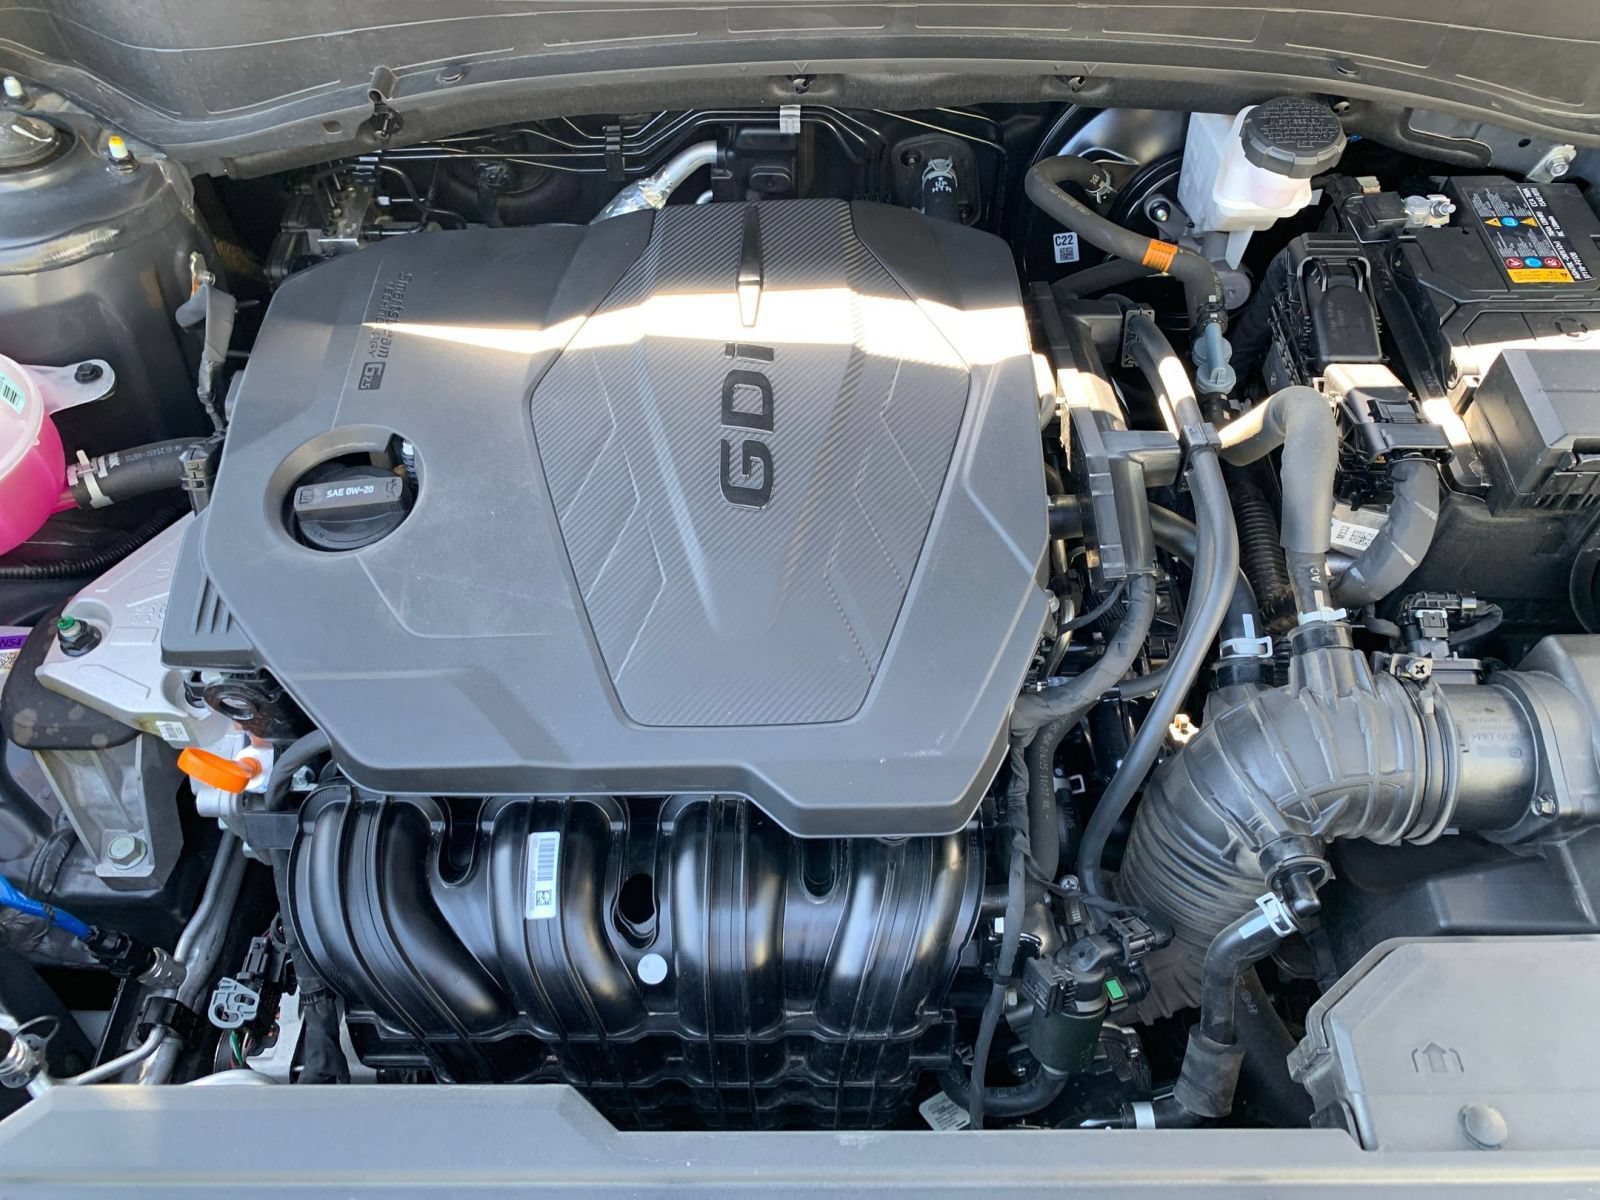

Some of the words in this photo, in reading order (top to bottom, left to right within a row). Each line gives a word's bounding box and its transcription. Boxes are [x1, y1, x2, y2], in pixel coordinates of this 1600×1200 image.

[1055, 235, 1074, 246] C22
[720, 342, 774, 511] GDi
[326, 489, 345, 498] SAE
[346, 485, 374, 496] 0W-20
[1310, 567, 1320, 583] AC
